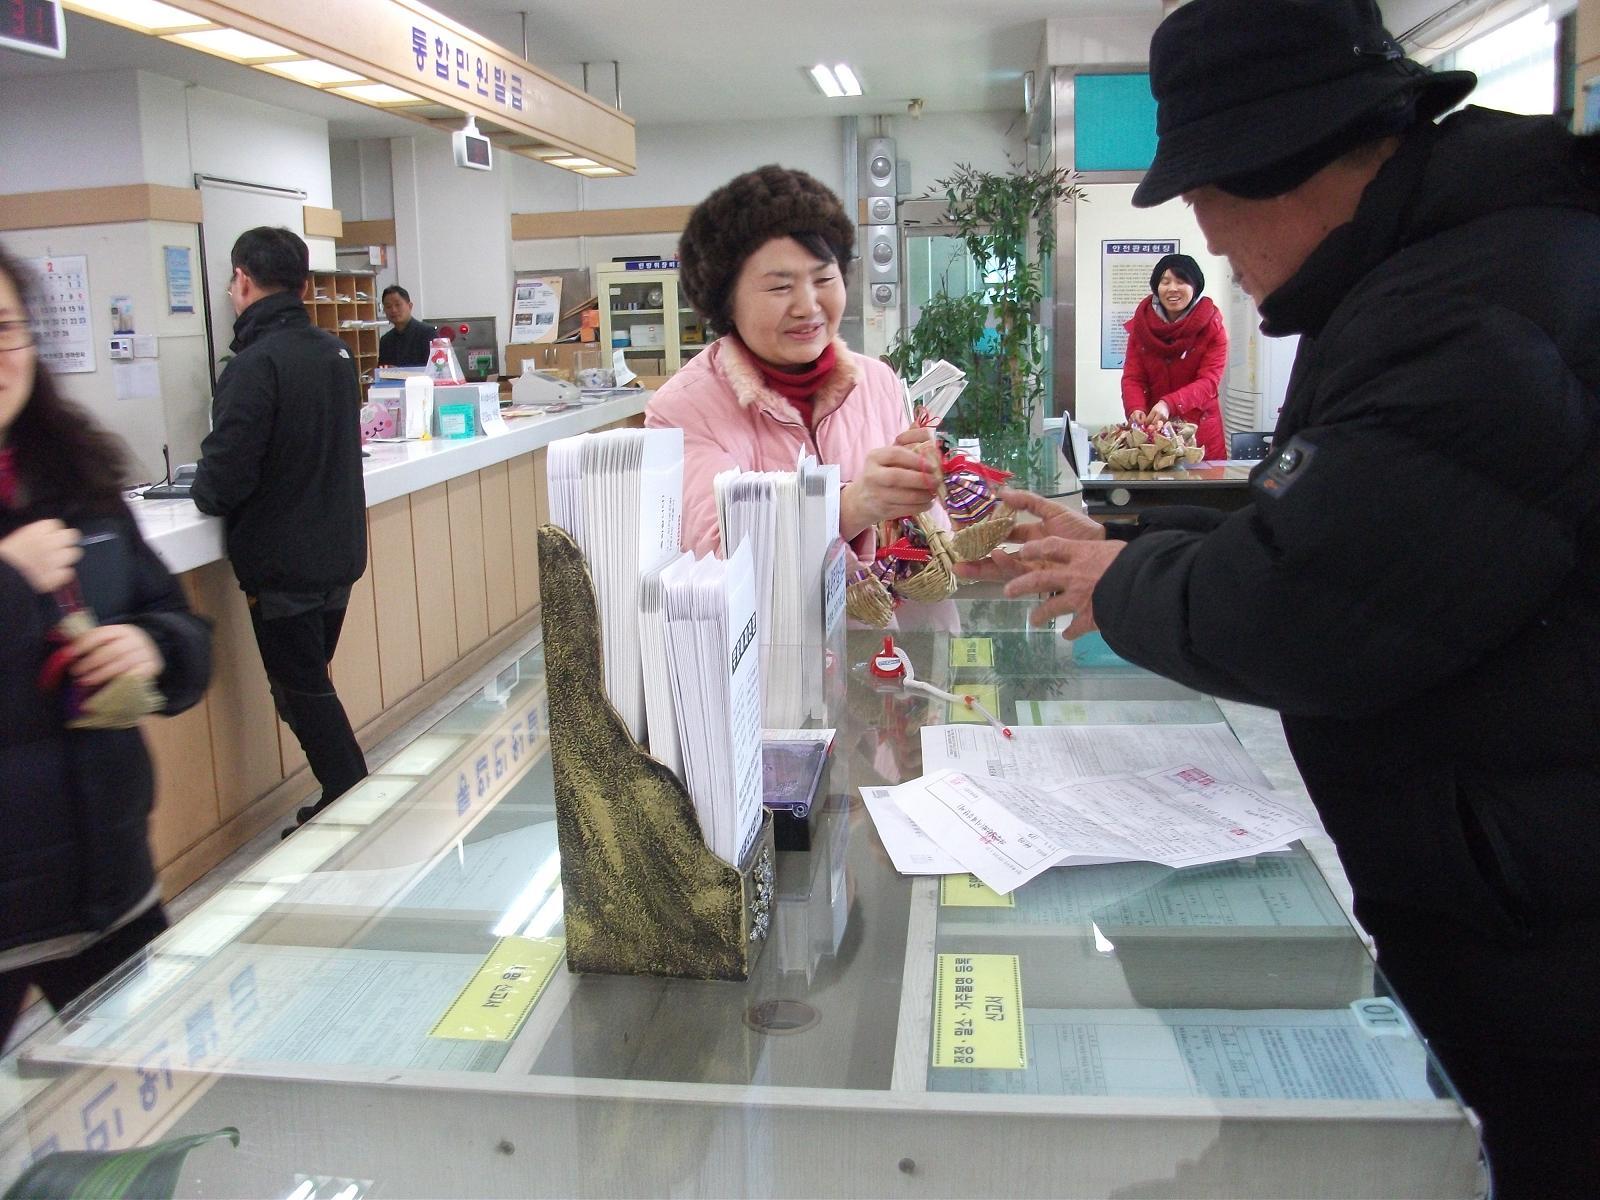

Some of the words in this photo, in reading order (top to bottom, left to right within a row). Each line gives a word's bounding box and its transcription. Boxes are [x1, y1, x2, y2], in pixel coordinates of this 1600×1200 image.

[412, 26, 522, 111] 통합민원발급
[1112, 244, 1171, 253] 안전관리헌장
[47, 262, 54, 272] 2
[59, 305, 67, 313] 14
[953, 957, 974, 973] 등록
[481, 984, 512, 1008] 신고서
[985, 996, 1004, 1022] 신고서
[1363, 1005, 1400, 1024] 10
